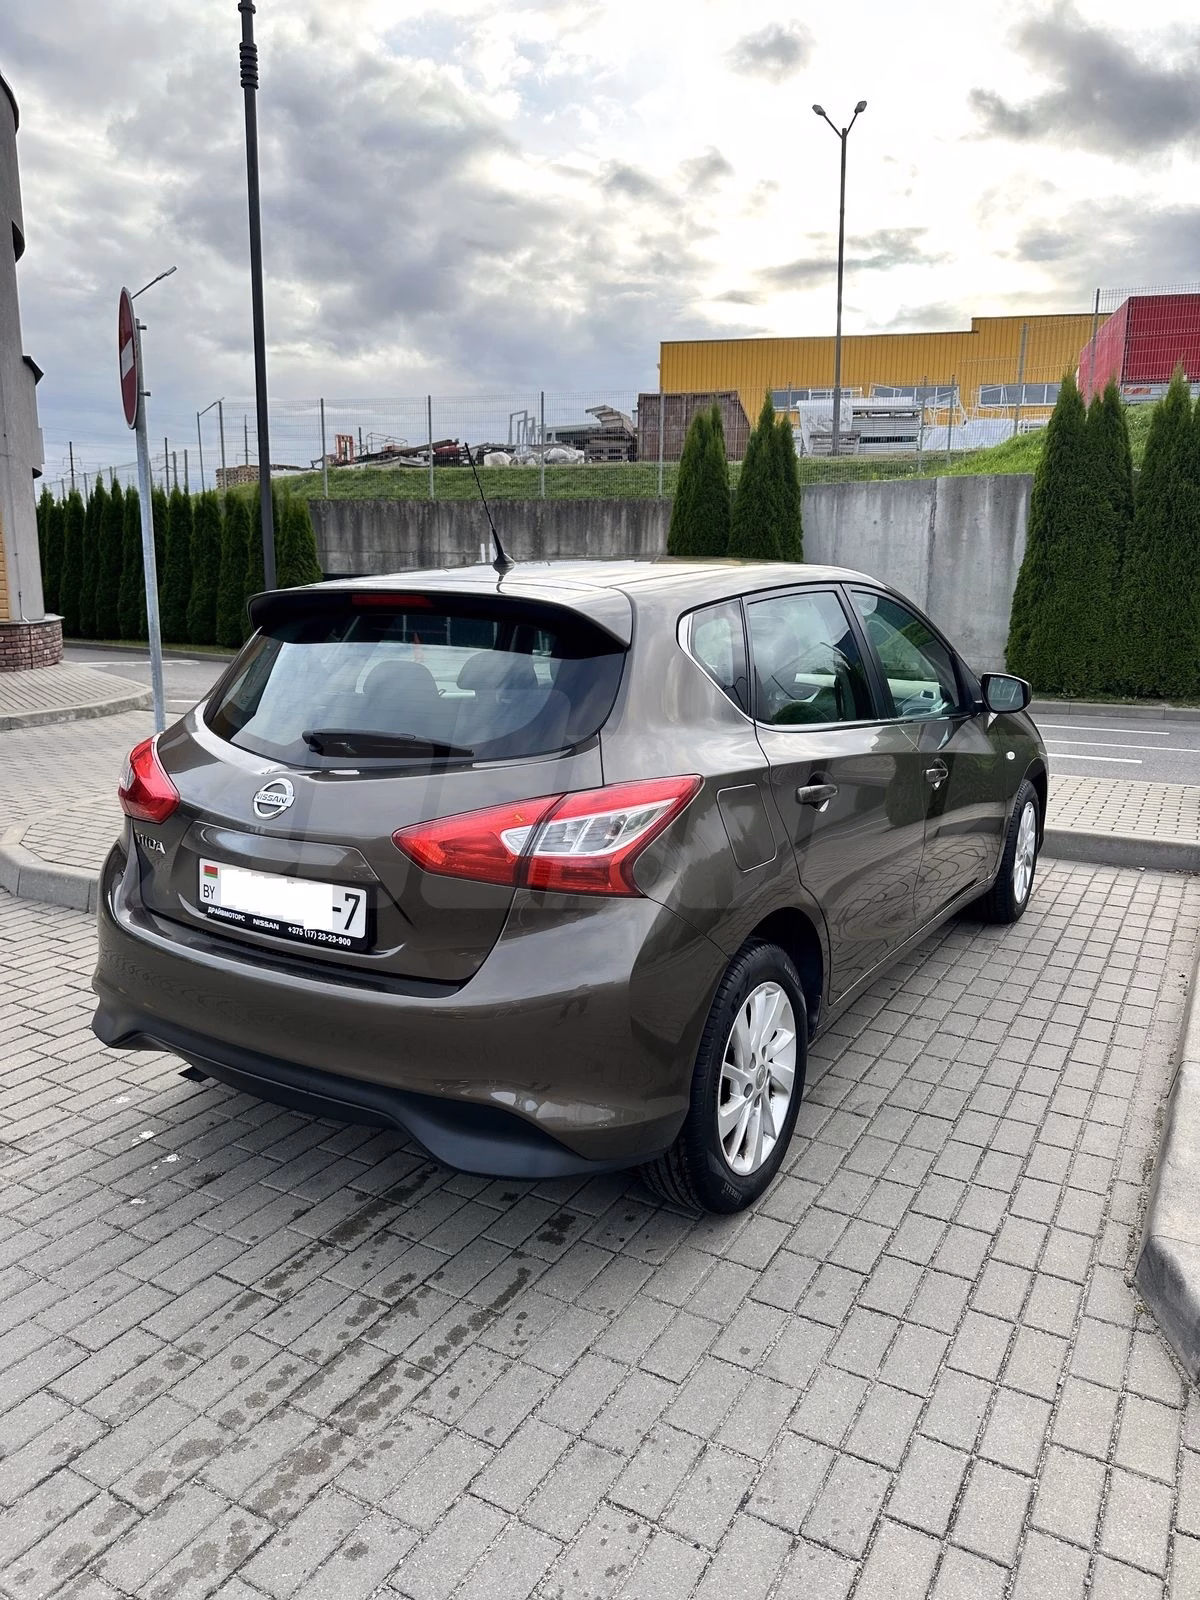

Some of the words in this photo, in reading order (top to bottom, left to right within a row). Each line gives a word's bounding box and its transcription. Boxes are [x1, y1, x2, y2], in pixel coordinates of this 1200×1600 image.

[256, 793, 287, 804] NISSAN
[203, 884, 215, 899] BY
[207, 906, 246, 922] ДРАЙВМОТОРС
[252, 918, 280, 930] NISSAN
[287, 926, 304, 936] +375
[304, 929, 317, 940] (17)
[317, 932, 351, 946] 23-23-900
